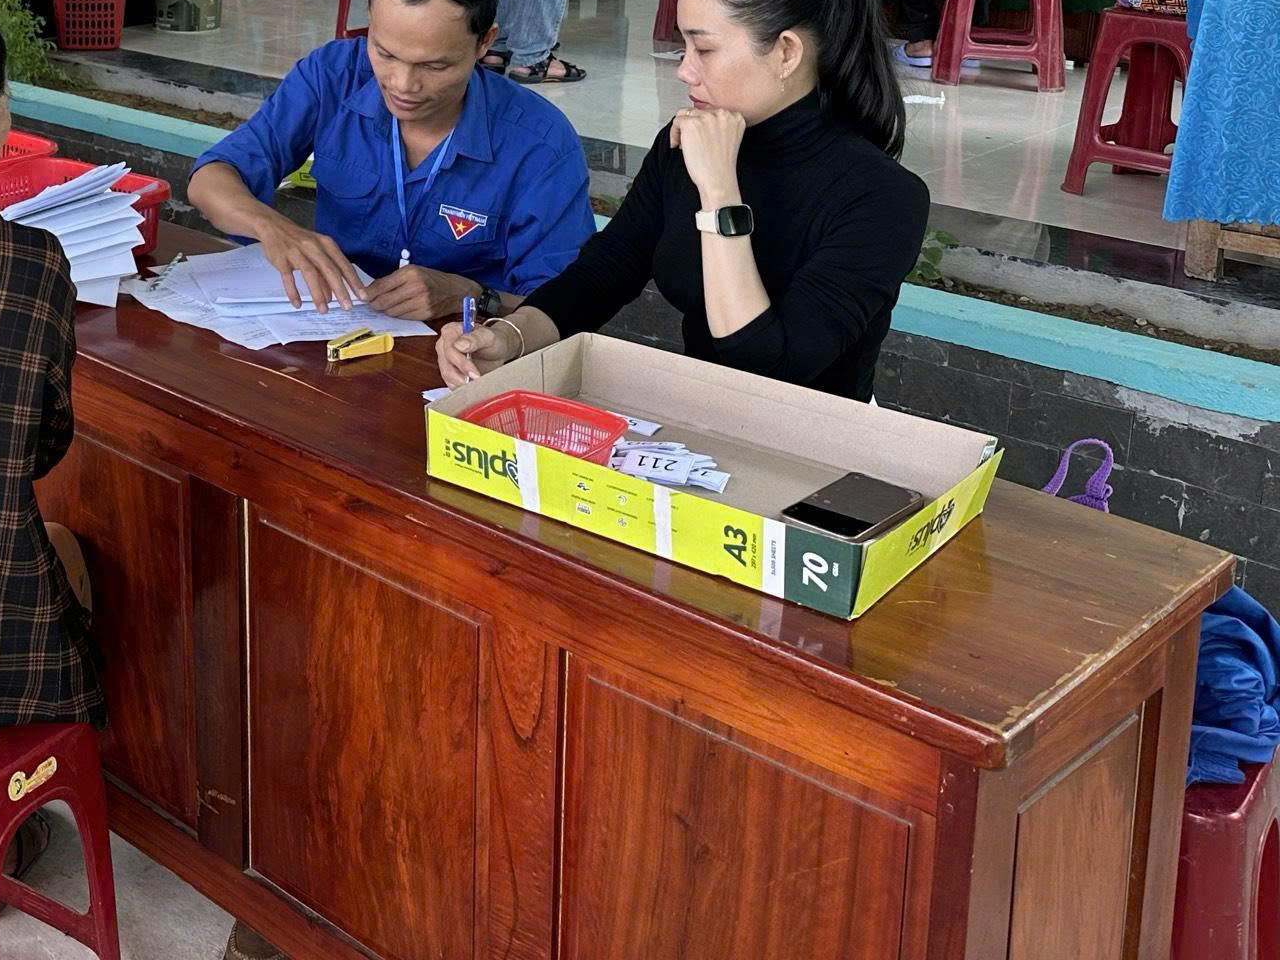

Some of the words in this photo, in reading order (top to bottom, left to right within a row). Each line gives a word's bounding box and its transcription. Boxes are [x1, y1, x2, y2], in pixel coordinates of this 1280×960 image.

[638, 455, 679, 472] 211
[723, 524, 748, 568] A3
[803, 552, 829, 592] 70
